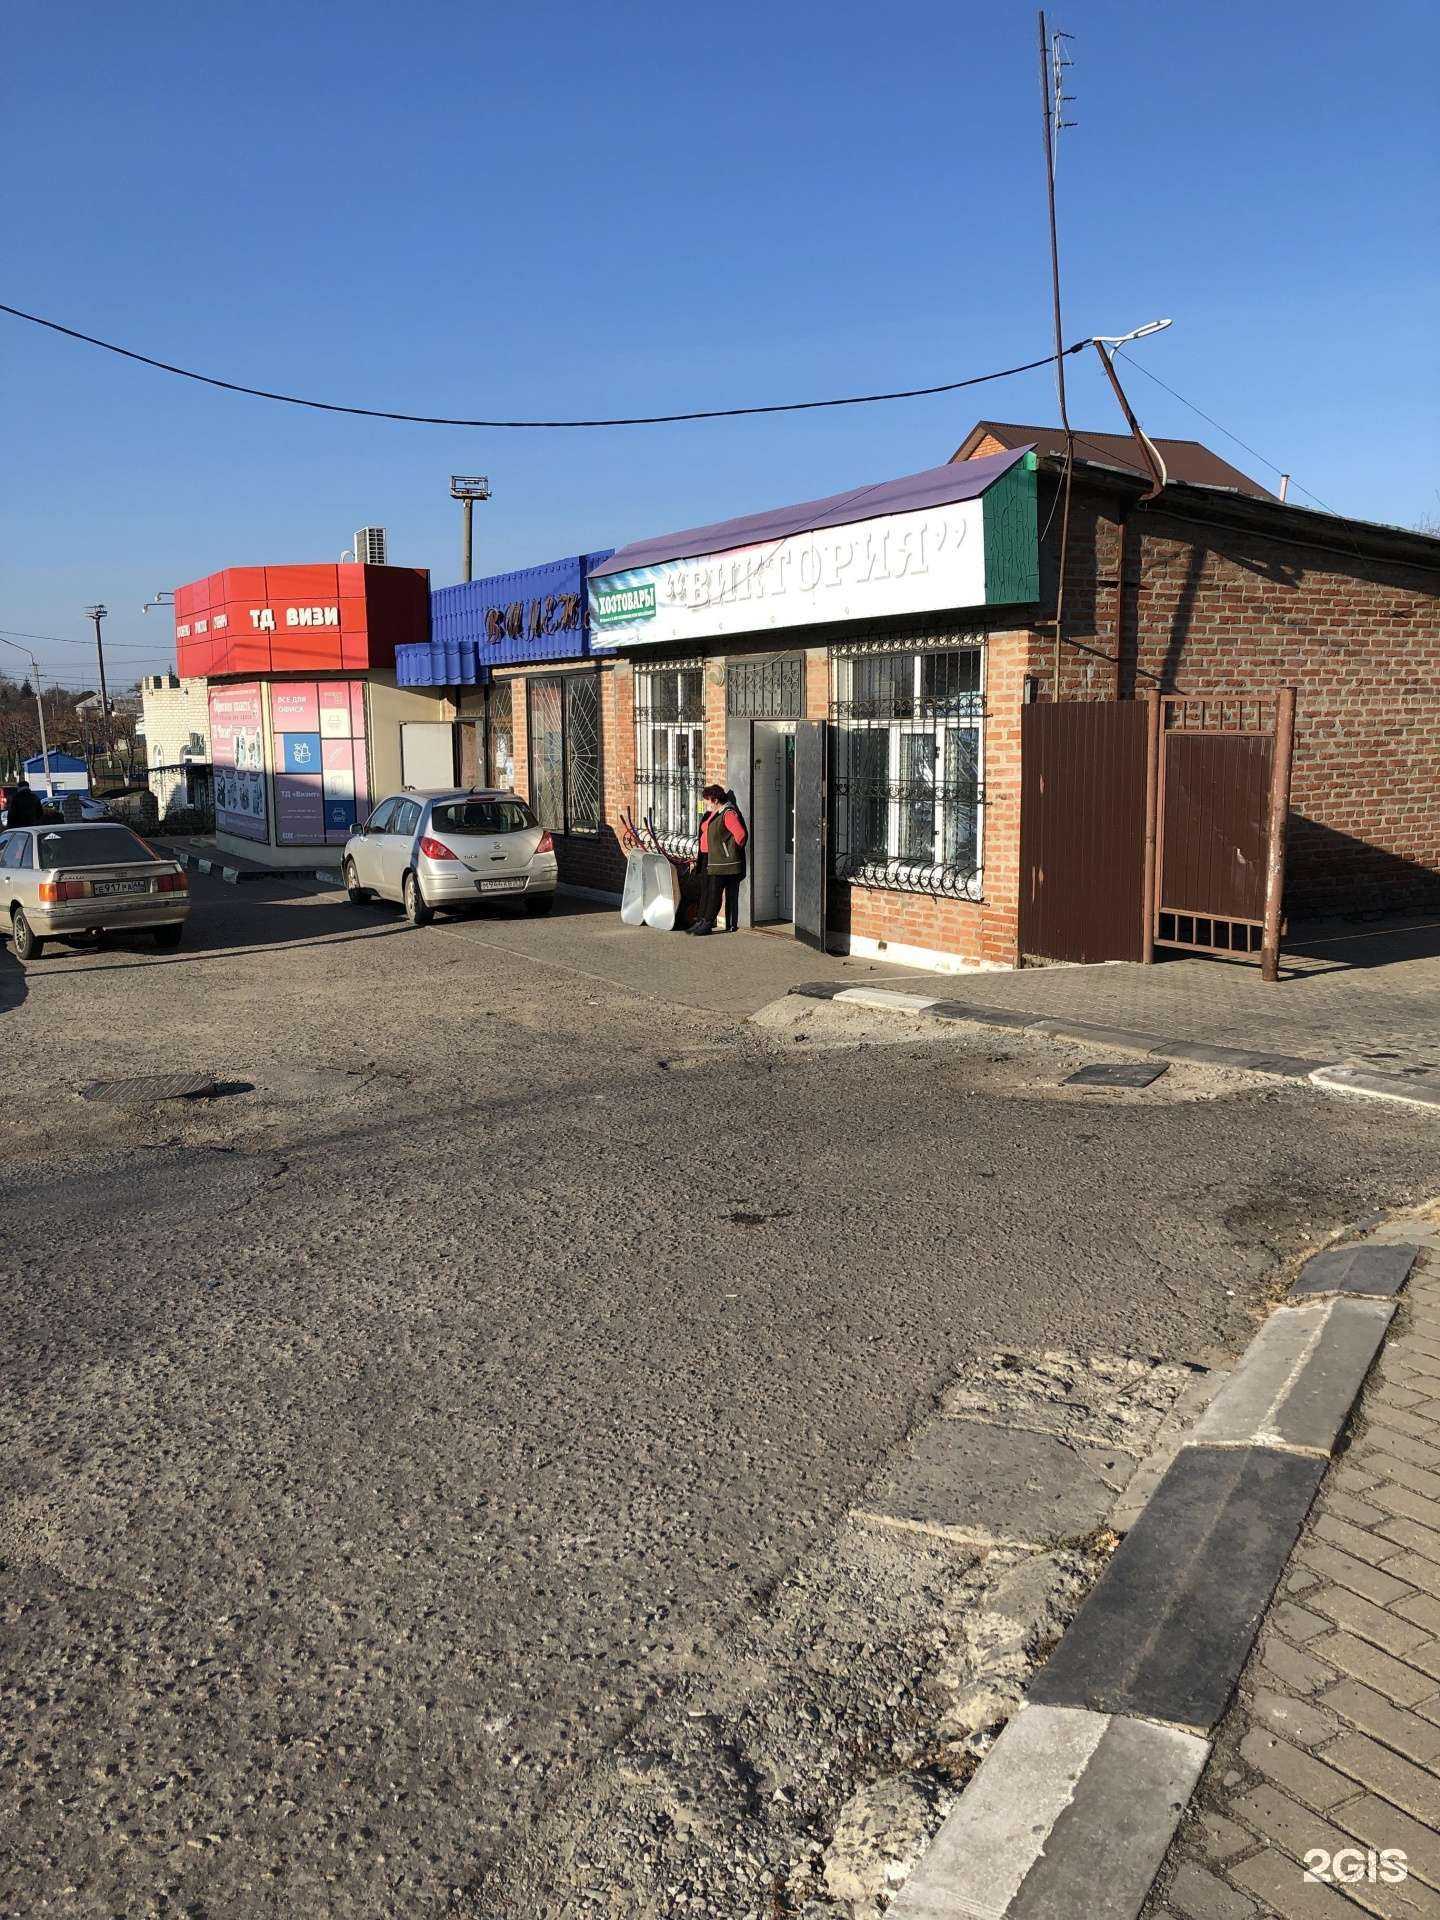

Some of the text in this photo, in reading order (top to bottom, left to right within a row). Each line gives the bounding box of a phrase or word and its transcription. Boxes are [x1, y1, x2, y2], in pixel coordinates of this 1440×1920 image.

[599, 586, 656, 616] ХОЗТОВАРЫ
[250, 608, 277, 632] ТД
[286, 606, 340, 627] ВИЗИ
